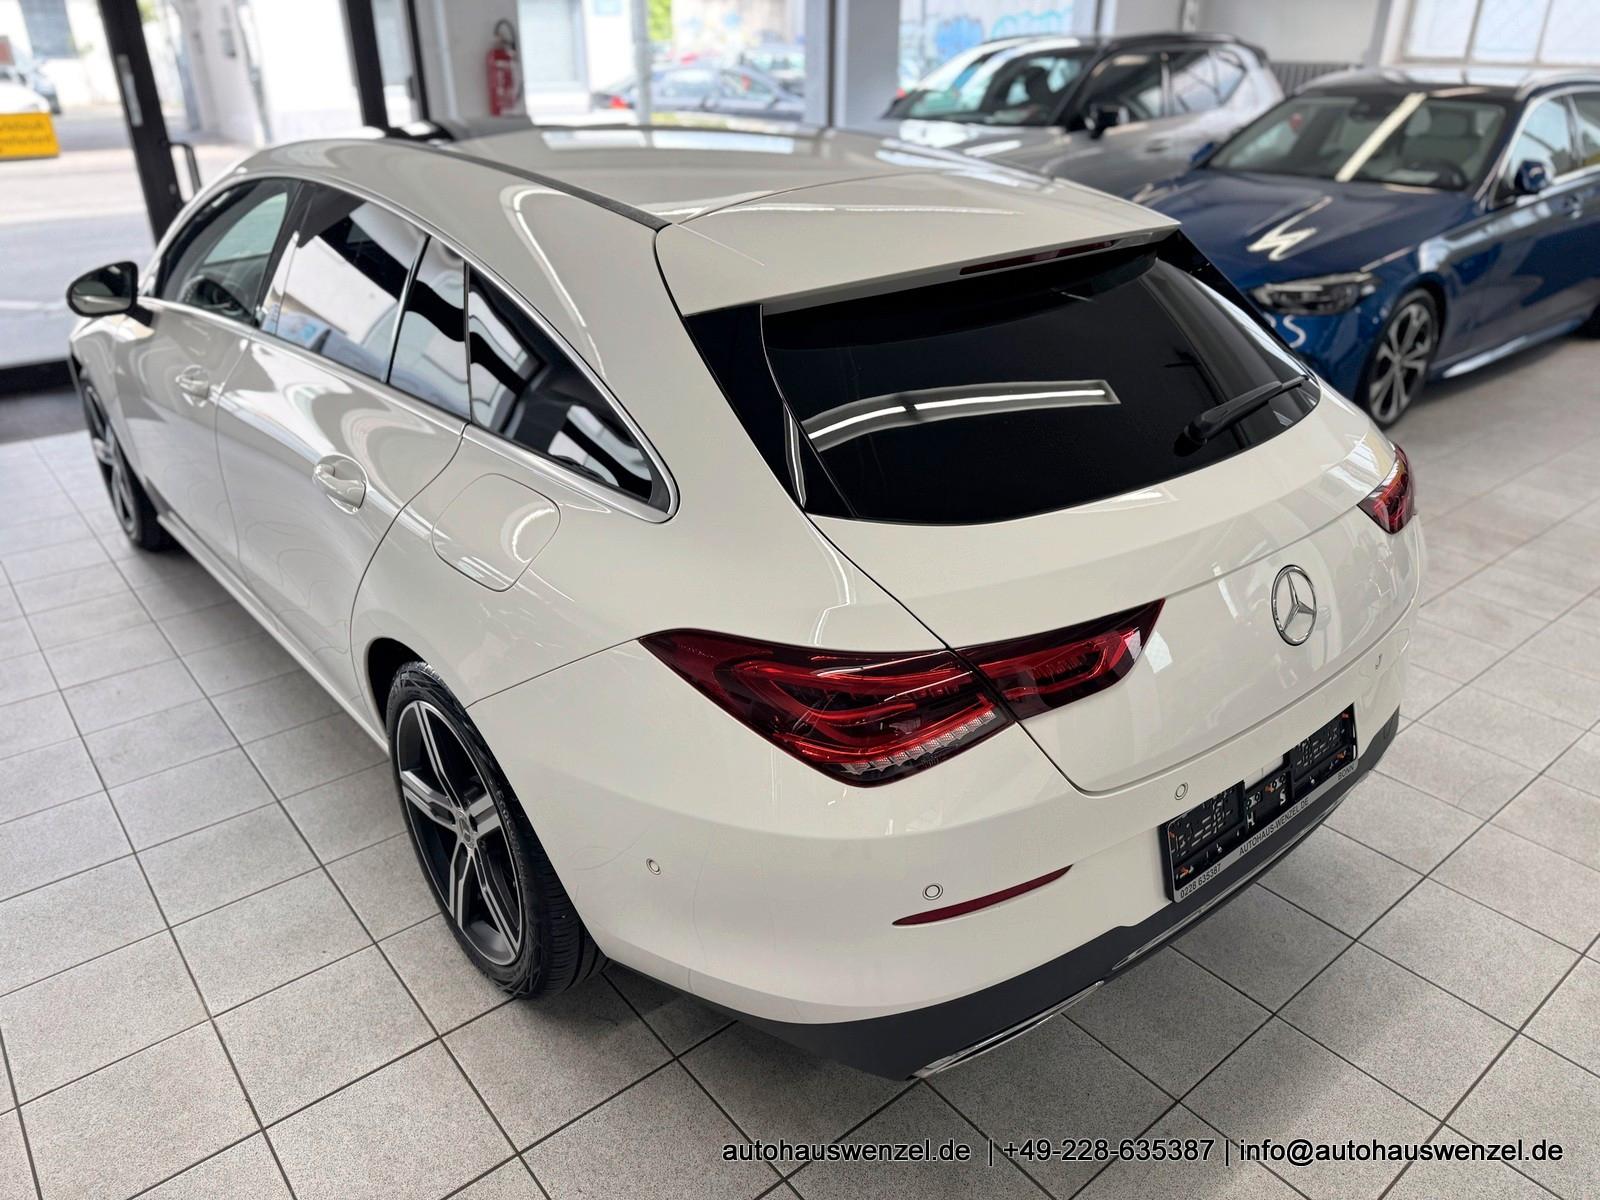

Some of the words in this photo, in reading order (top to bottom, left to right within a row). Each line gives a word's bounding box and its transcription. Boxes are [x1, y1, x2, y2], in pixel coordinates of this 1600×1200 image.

[1180, 880, 1197, 898] 0228
[1198, 863, 1221, 886] 635387
[1239, 797, 1309, 856] AUTOHAUS-WENZEL.DE
[1336, 762, 1355, 780] BONN
